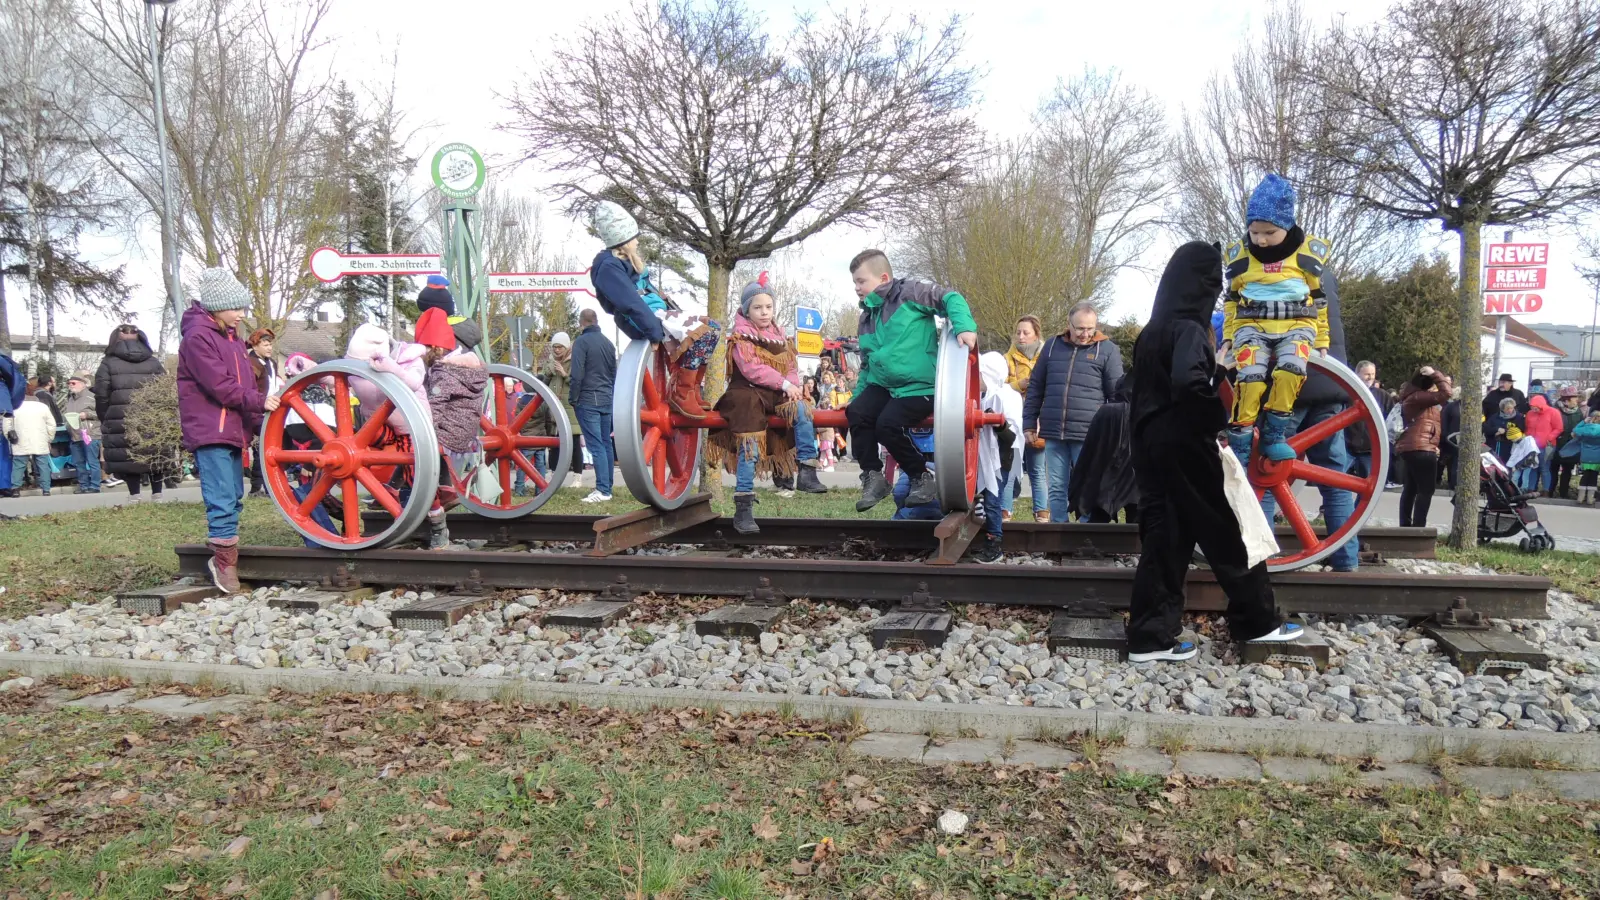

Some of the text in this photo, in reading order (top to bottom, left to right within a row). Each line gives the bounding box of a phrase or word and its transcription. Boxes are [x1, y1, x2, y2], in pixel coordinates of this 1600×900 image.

[440, 144, 474, 155] Ehemalige
[1490, 245, 1546, 263] REWE
[349, 259, 432, 270] Ehem. Bahnstrecke
[1495, 269, 1538, 282] REWE
[498, 277, 578, 287] Ehem. Bahnstrecke
[1485, 293, 1543, 313] NKD
